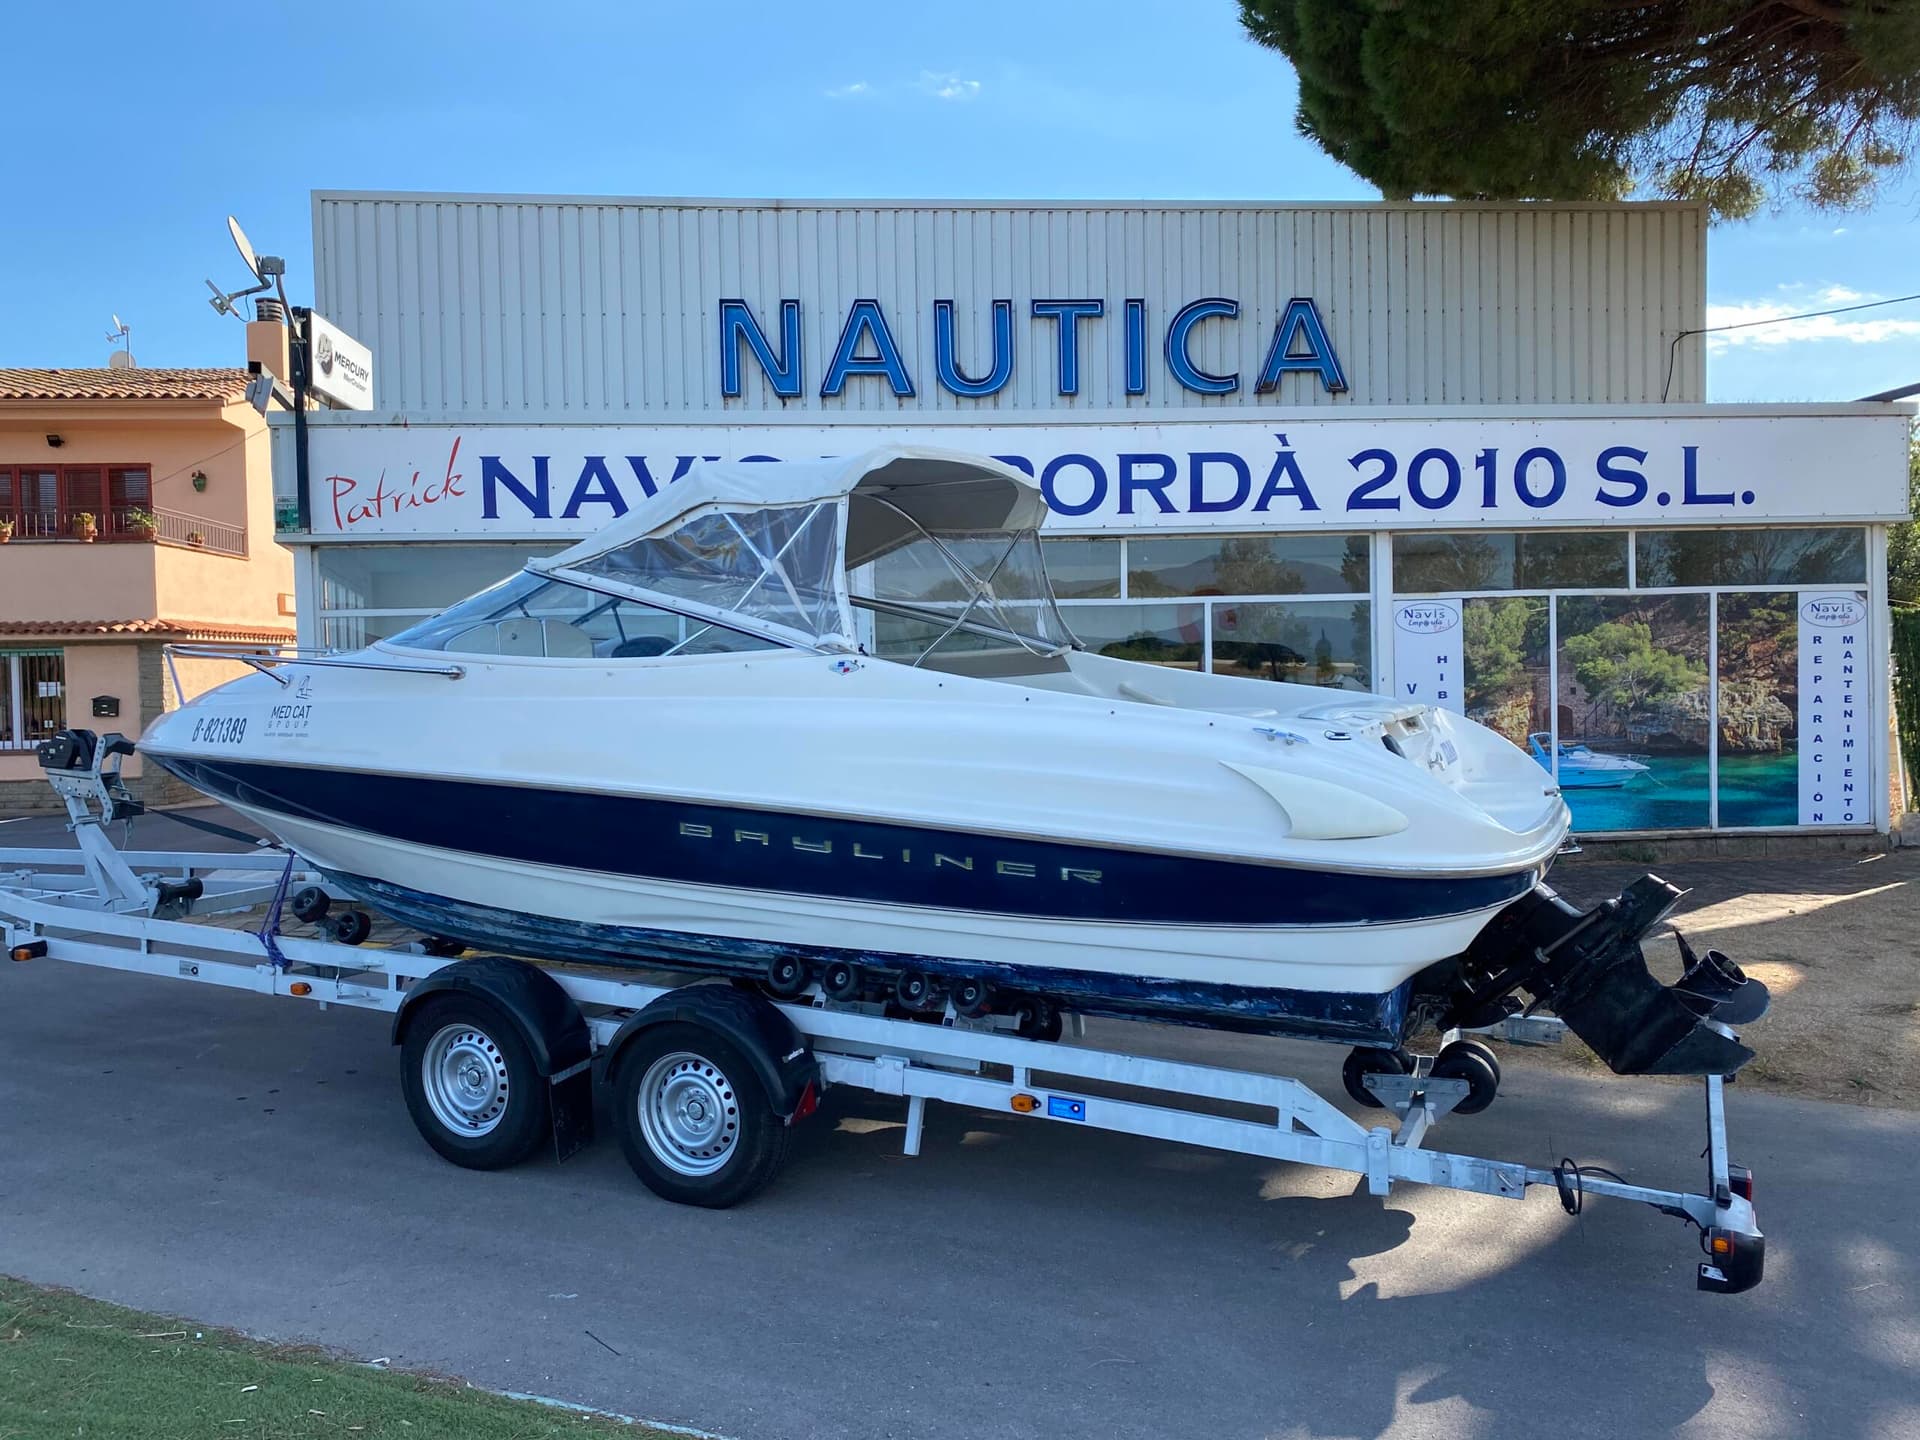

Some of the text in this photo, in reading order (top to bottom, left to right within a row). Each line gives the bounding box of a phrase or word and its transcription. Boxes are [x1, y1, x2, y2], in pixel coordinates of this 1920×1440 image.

[334, 351, 369, 382] MERCURY
[719, 297, 1349, 397] NAUTICA
[325, 435, 465, 530] Patrick
[1346, 447, 1567, 512] 2010
[1595, 446, 1756, 507] S.L.
[1404, 608, 1446, 619] Navis
[1811, 603, 1853, 612] Navis
[191, 717, 248, 744] B-821389
[271, 705, 312, 719] MED CAT
[1813, 635, 1822, 822] REPARACIÓN
[1842, 635, 1853, 822] MANTENIMIENTO
[679, 822, 1102, 884] BAYLINER
